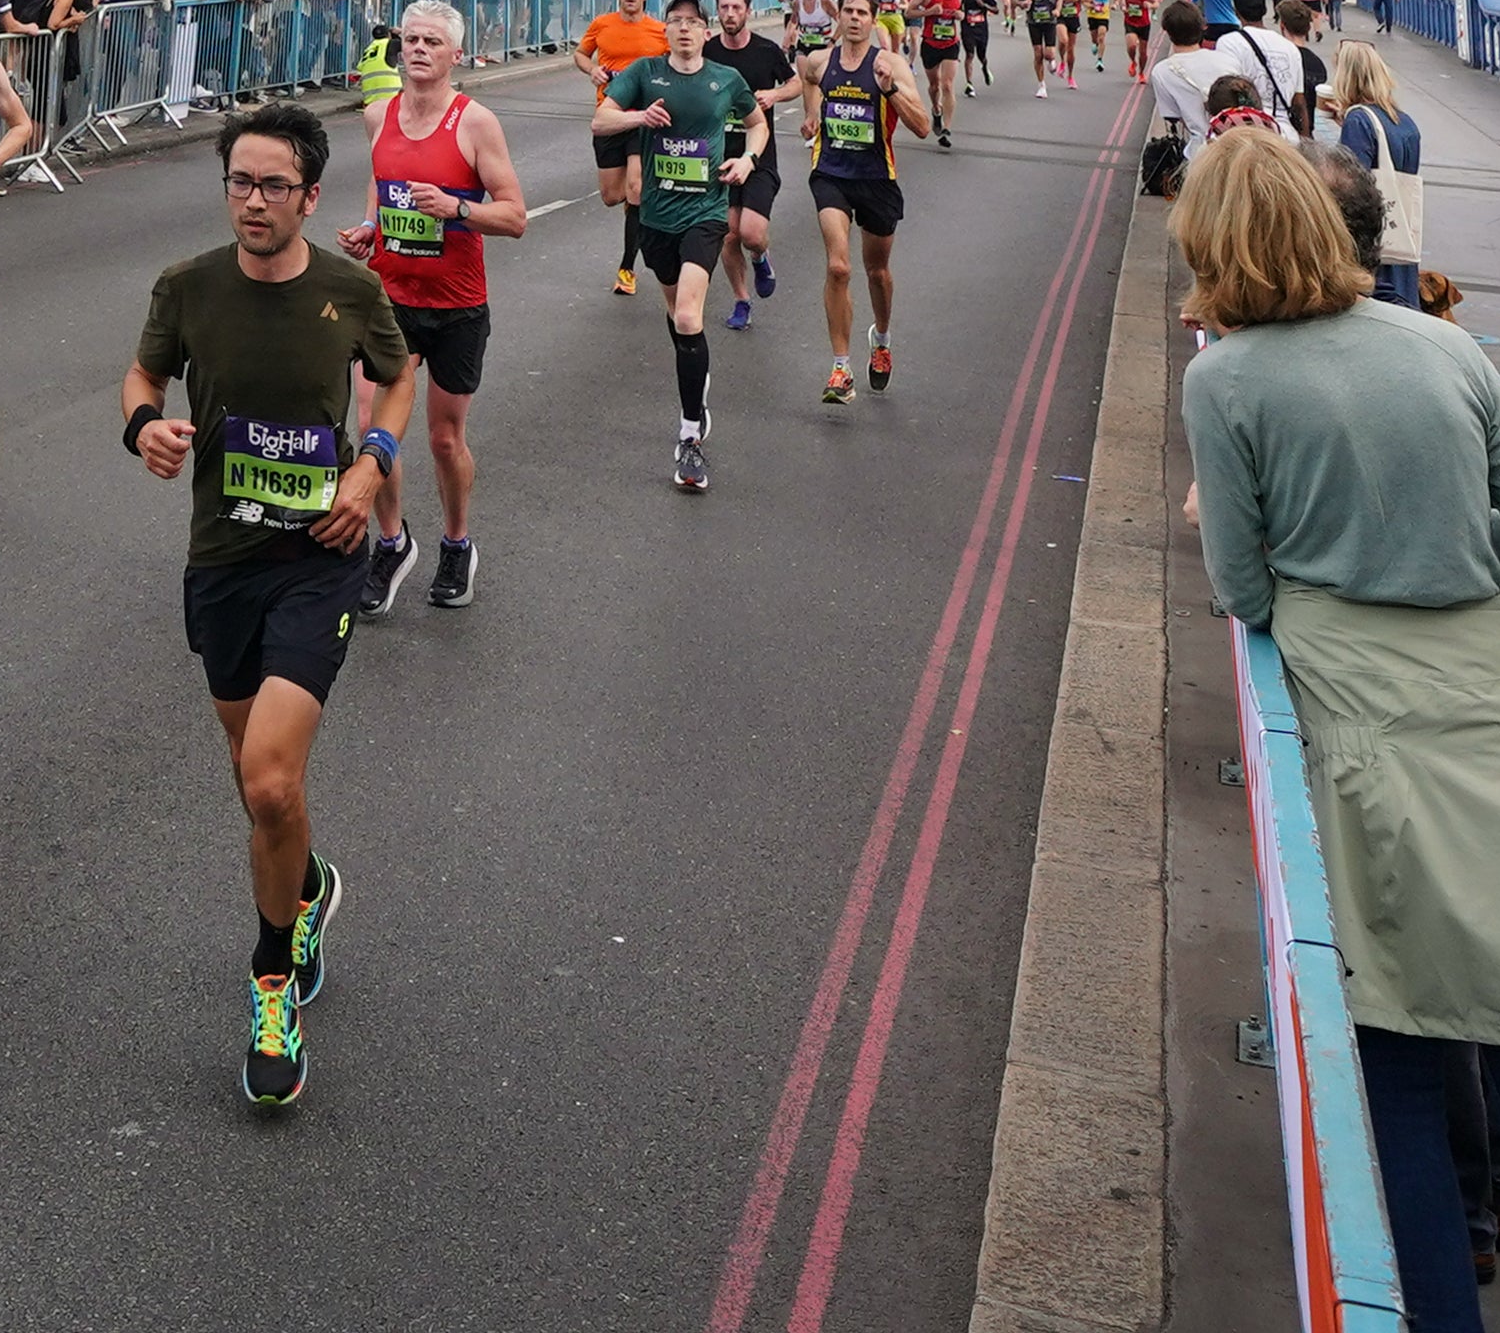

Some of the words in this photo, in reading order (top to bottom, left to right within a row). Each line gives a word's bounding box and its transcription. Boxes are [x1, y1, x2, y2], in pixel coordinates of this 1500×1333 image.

[445, 106, 461, 131] soar
[666, 162, 686, 175] 979
[382, 214, 391, 230] N
[392, 215, 426, 235] 11749
[231, 463, 245, 487] N
[251, 466, 312, 501] 11639
[264, 518, 283, 529] new
